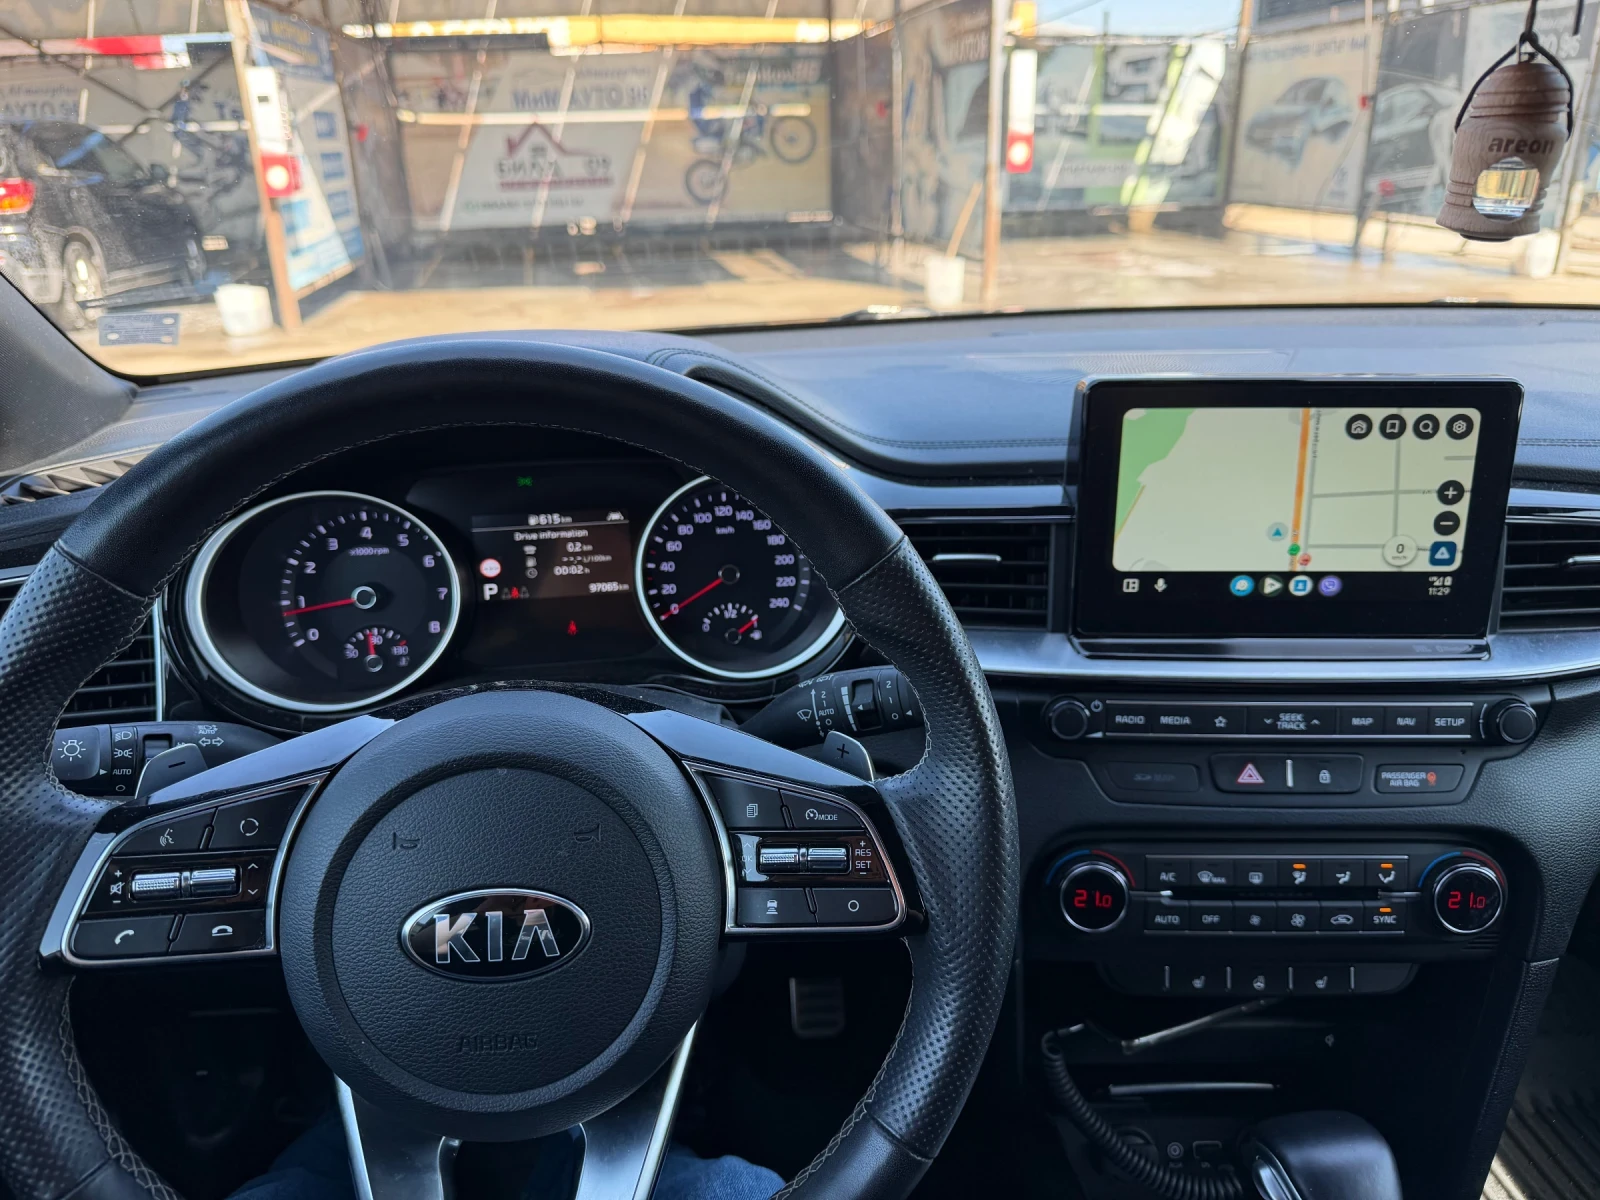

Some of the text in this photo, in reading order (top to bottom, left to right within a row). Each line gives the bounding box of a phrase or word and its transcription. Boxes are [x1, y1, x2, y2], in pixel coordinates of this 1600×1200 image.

[1488, 137, 1554, 155] areon
[714, 506, 733, 516] 120
[735, 510, 754, 521] 140
[693, 513, 712, 524] 100
[677, 524, 694, 535] 80
[715, 526, 735, 535] km/h
[752, 519, 772, 531] 160
[360, 526, 373, 539] 4
[514, 529, 589, 541] Drive information
[327, 538, 339, 551] 3
[397, 534, 409, 547] 5
[766, 535, 785, 546] 180
[666, 541, 682, 552] 60
[1396, 543, 1405, 554] 0
[422, 555, 435, 568] 6
[774, 554, 795, 566] 200
[304, 561, 316, 574] 2
[553, 565, 583, 575] 00:02
[660, 561, 675, 573] 40
[776, 576, 796, 587] 220
[437, 587, 448, 600] 7
[483, 583, 499, 601] P
[661, 583, 677, 595] 20
[1428, 587, 1451, 596] 11:29
[297, 595, 306, 609] 1
[769, 598, 790, 609] 240
[428, 621, 441, 634] 8
[307, 628, 319, 641] 0
[886, 680, 892, 688] 2
[818, 708, 835, 716] AUTO
[1278, 713, 1303, 722] SEEK
[1115, 715, 1146, 725] RADIO
[1160, 716, 1192, 726] MEDIA
[1351, 717, 1374, 726] MAP
[1396, 717, 1416, 726] NAV
[1434, 717, 1465, 727] SETUP
[1276, 721, 1306, 731] TRACK
[112, 767, 132, 776] AUTO
[1381, 771, 1427, 779] PASSENGER
[818, 813, 838, 821] MODE
[854, 848, 872, 857] RES
[855, 860, 872, 869] SET
[1159, 871, 1177, 882] A/C
[1154, 915, 1181, 925] AUTO
[1202, 915, 1220, 924] OFF
[1373, 915, 1397, 924] SYNC
[433, 908, 561, 964] KIA
